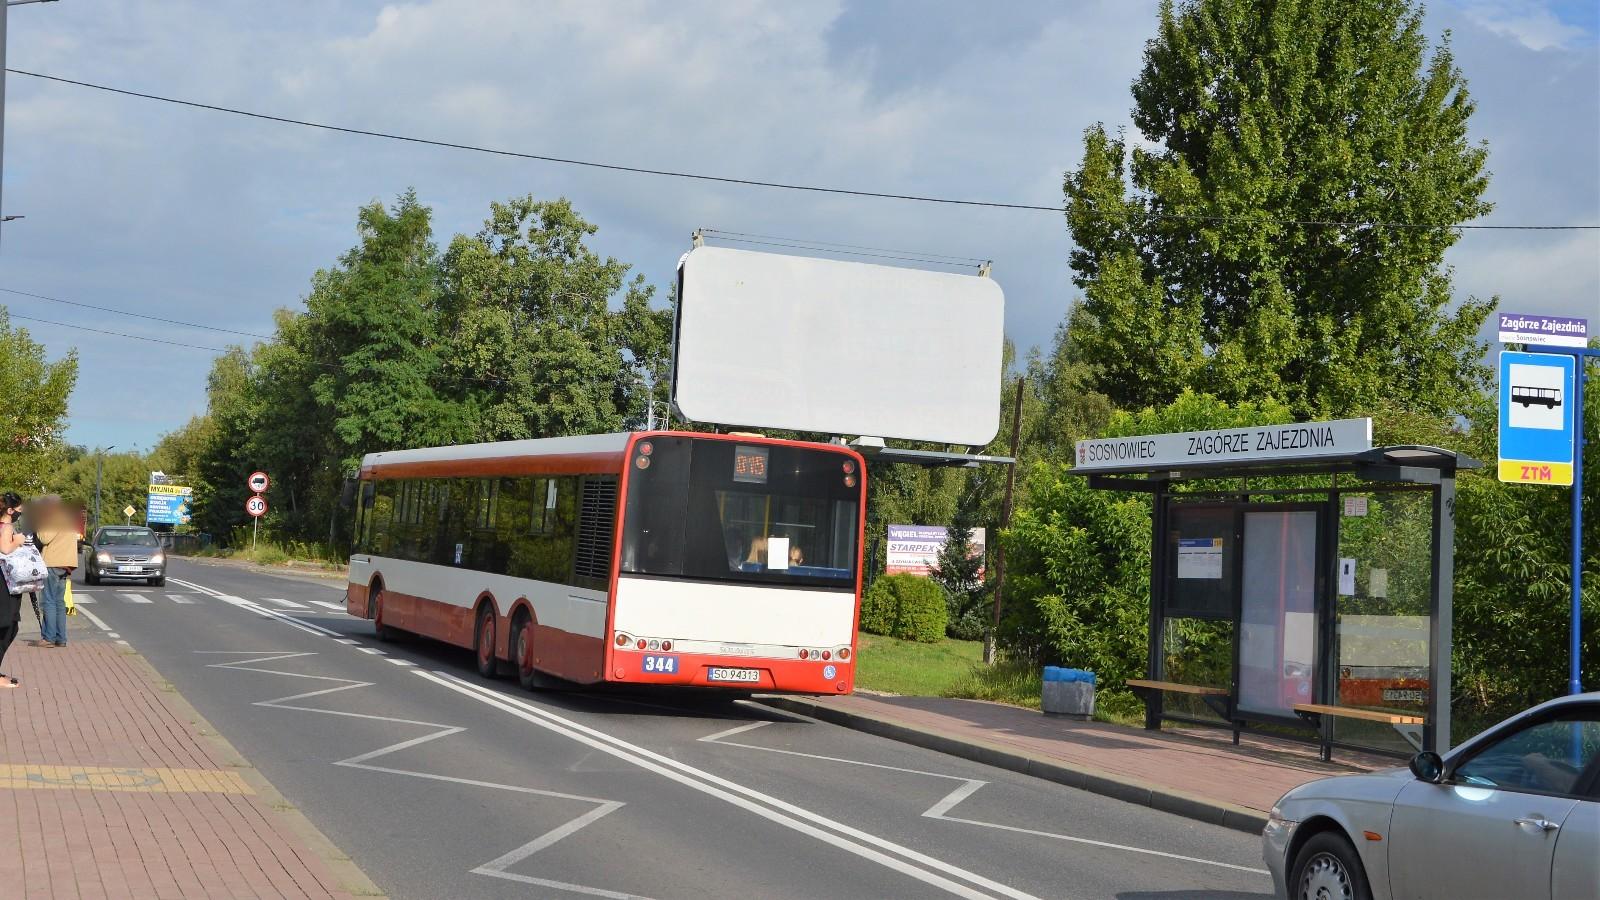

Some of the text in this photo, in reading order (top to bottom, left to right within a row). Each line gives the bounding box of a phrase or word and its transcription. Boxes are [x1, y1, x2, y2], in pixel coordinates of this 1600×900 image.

[1501, 316, 1586, 334] Zagórze Zajezdnia
[1089, 427, 1335, 462] SOSNOWIEC ZAGÓRZE ZAJEZDNIA
[1520, 465, 1552, 481] ZTM
[250, 501, 264, 511] 30
[890, 544, 935, 552] STARPEX
[645, 656, 674, 672] 344
[714, 670, 759, 681] SO 94313
